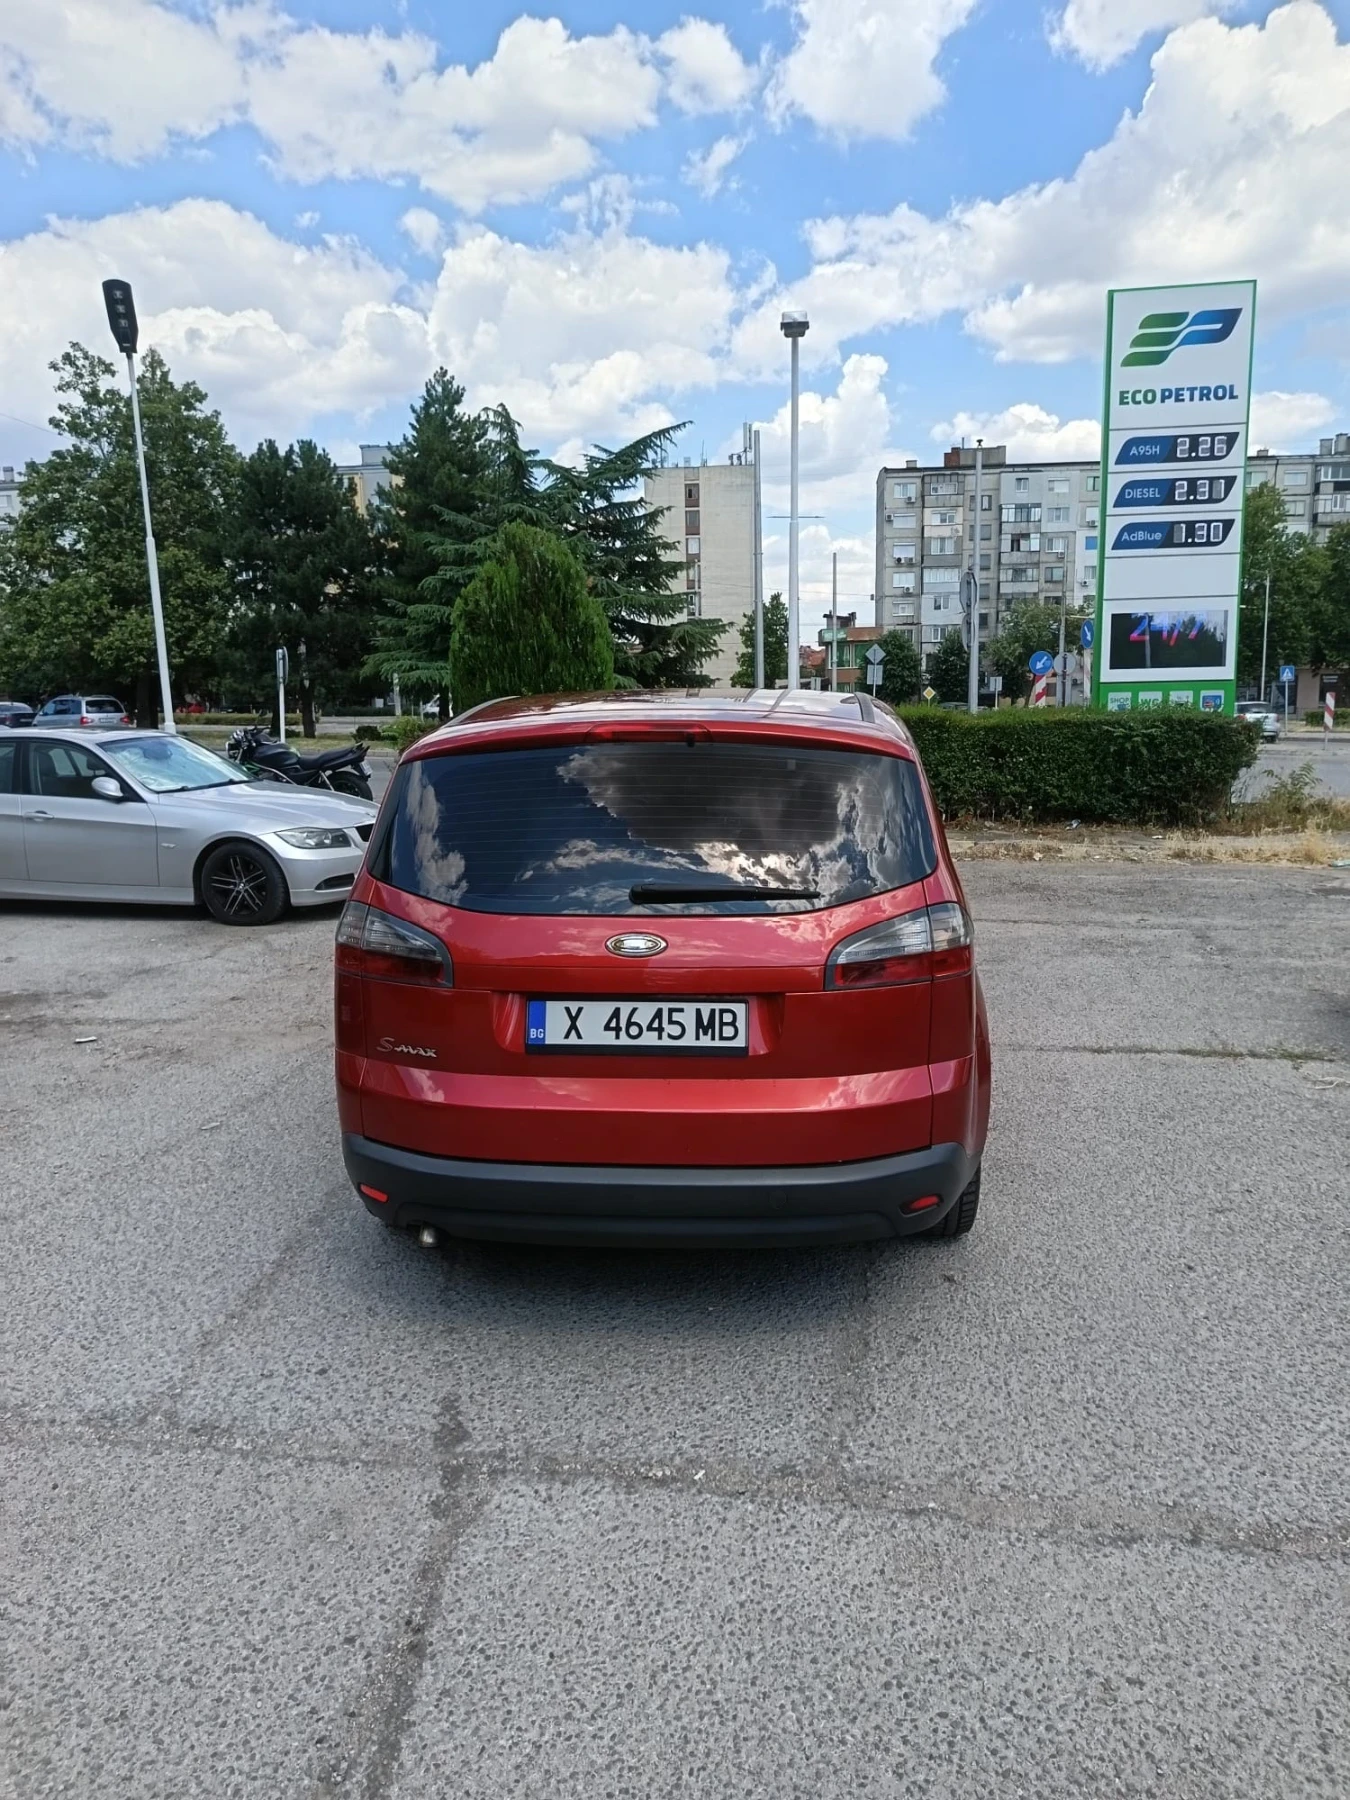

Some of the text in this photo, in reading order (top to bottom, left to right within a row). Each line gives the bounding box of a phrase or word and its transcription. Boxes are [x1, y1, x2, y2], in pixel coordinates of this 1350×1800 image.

[1119, 384, 1239, 406] ECO PETROL
[1129, 436, 1227, 458] A95H 2.26
[1125, 480, 1225, 501] DIESEL 2.31
[1121, 522, 1223, 543] AdBlue 1.30
[530, 1006, 739, 1042] BG X 4645 MB
